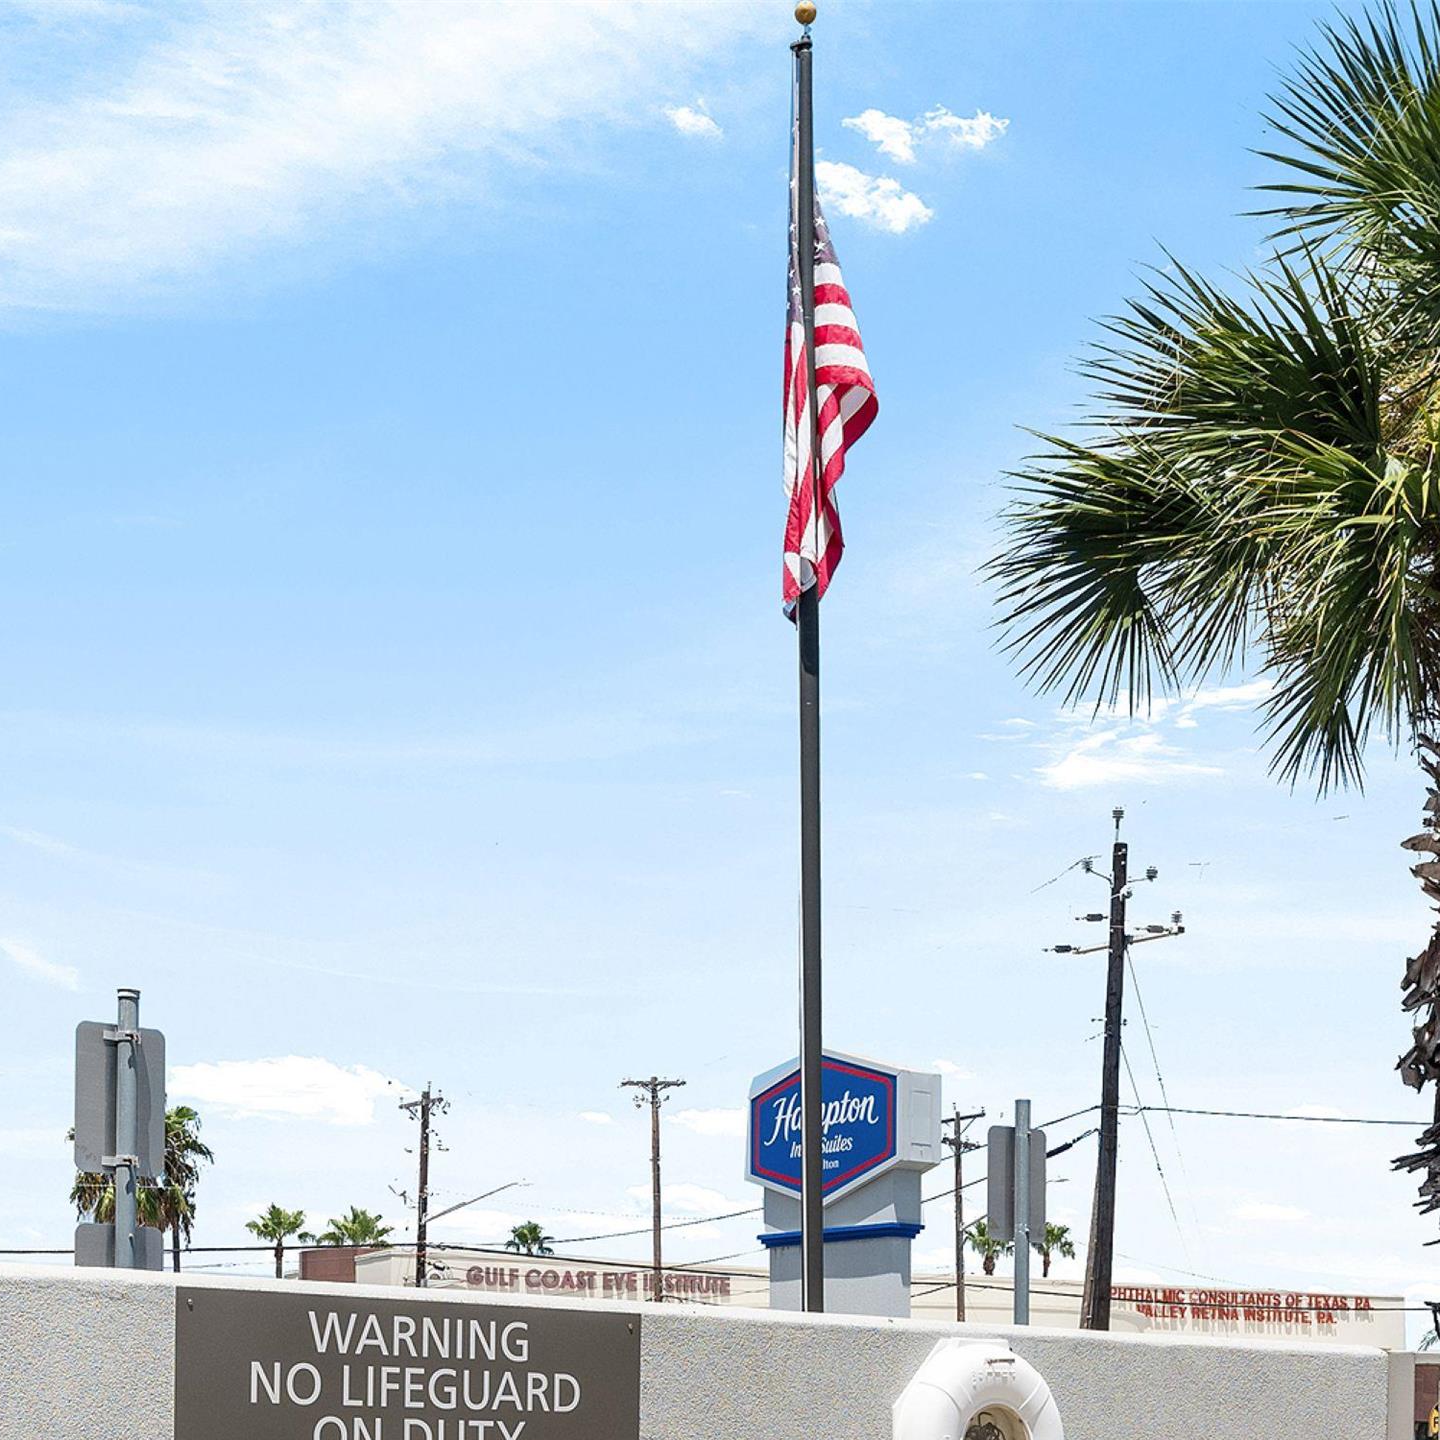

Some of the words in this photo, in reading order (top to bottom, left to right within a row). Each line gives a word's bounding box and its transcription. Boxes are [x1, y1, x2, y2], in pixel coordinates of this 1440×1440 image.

[764, 1091, 879, 1146] Hapton
[466, 1265, 520, 1287] GULF
[525, 1269, 597, 1290] COAST
[602, 1271, 638, 1292] EYE
[1110, 1287, 1185, 1304] PHTHALMIC
[1189, 1288, 1281, 1308] CONSULTANTS
[1285, 1293, 1301, 1308] OF
[1136, 1303, 1187, 1319] VALLEY
[1191, 1306, 1239, 1321] RETINA
[308, 1310, 529, 1363] WARNING
[250, 1361, 322, 1406] NO
[343, 1365, 582, 1413] LIFEGUARD
